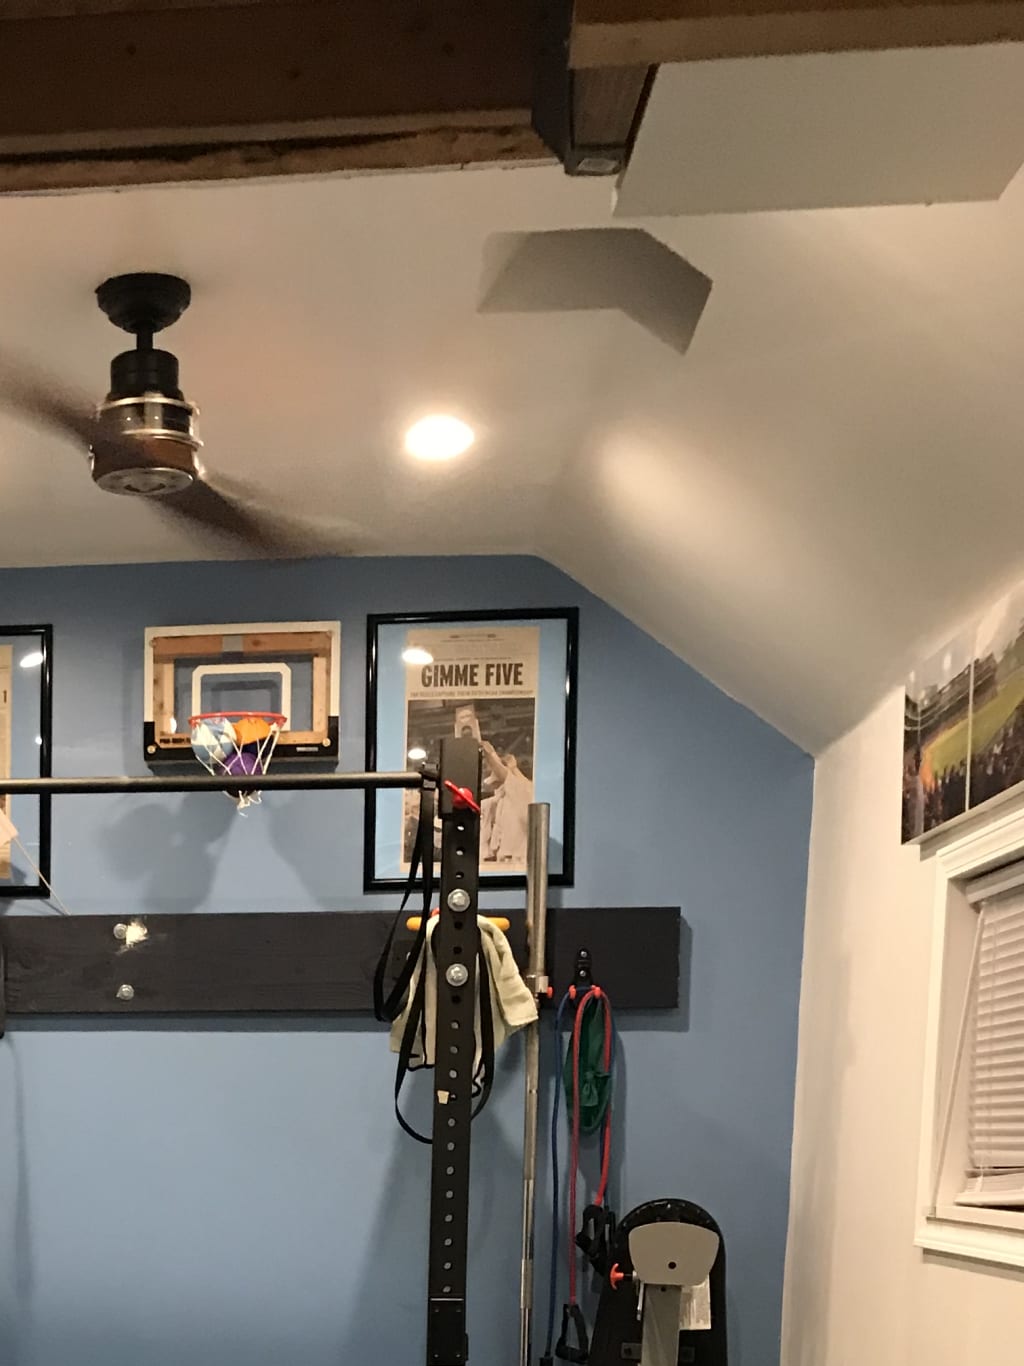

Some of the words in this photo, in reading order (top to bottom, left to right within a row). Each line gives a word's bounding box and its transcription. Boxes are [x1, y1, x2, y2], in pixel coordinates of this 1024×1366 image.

[421, 664, 480, 688] GIMME
[485, 663, 524, 686] FIVE
[3, 690, 8, 703] 1
